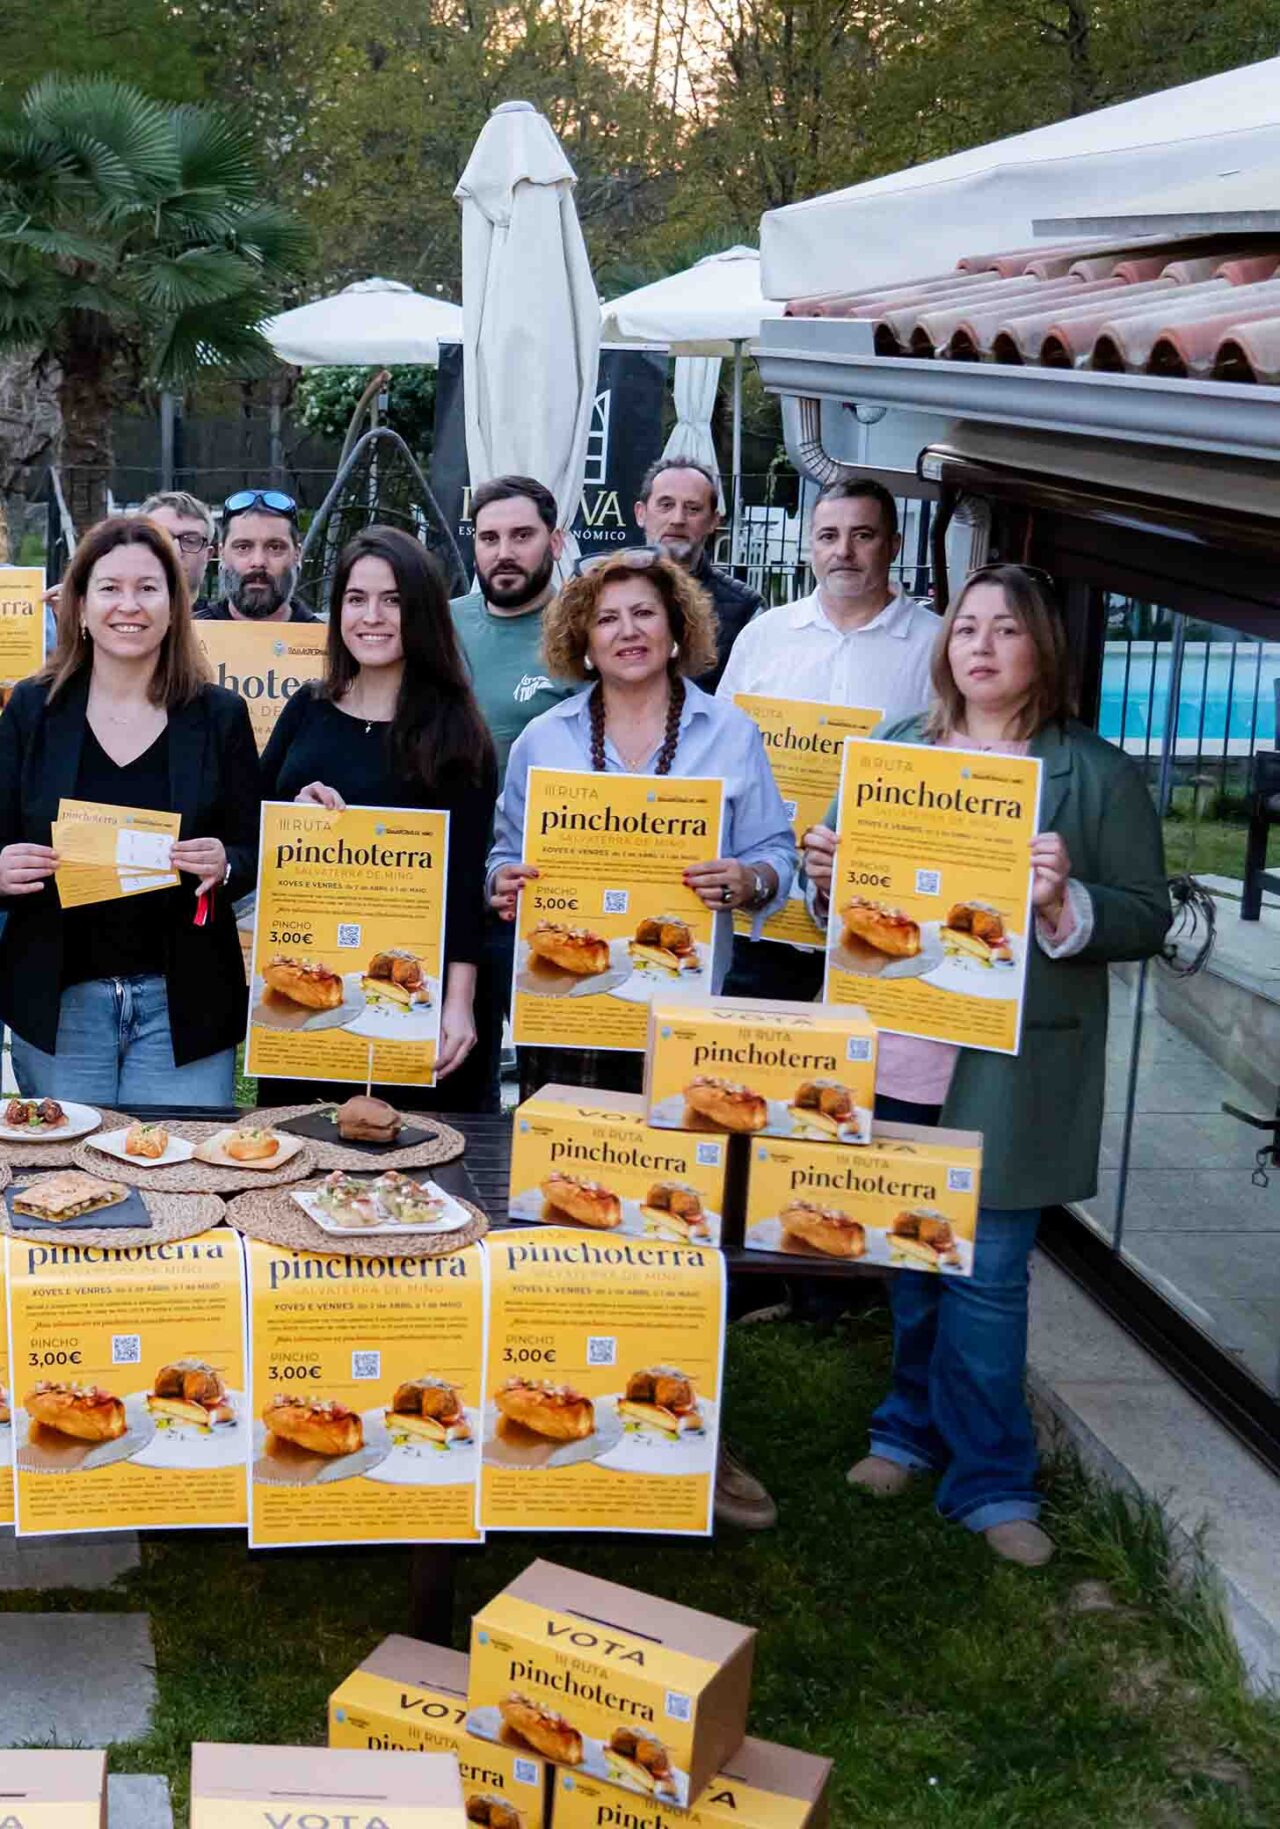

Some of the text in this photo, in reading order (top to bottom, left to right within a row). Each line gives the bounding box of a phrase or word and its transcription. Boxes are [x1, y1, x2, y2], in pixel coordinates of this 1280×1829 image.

[558, 786, 599, 800] RUTA
[856, 777, 1022, 819] pinchoterra
[292, 819, 332, 831] RUTA
[541, 805, 707, 836] pinchoterra
[276, 838, 432, 869] pinchoterra
[313, 881, 343, 890] VENRES
[847, 872, 891, 888] 3,00€
[534, 897, 578, 911] 3,00€
[272, 920, 311, 929] PINCHO
[269, 931, 313, 946] 3,00€
[694, 1041, 837, 1071] pinchoterra
[550, 1138, 687, 1173] pinchoterra
[791, 1166, 937, 1200] pinchoterra
[507, 1242, 705, 1271] pinchoterra
[270, 1252, 466, 1289] pinchoterra
[75, 1286, 112, 1296] VENRES
[555, 1287, 591, 1295] VENRES
[274, 1303, 305, 1311] XOVES
[317, 1302, 354, 1311] VENRES
[30, 1338, 78, 1348] PINCHO
[506, 1335, 555, 1345] PINCHO
[29, 1351, 82, 1368] 3,00€
[271, 1352, 319, 1363] PINCHO
[502, 1348, 556, 1363] 3,00€
[268, 1366, 322, 1383] 3,00€
[545, 1620, 646, 1667] VOTA
[570, 1658, 610, 1680] RUTA
[508, 1658, 656, 1723] pinchoterra
[424, 1731, 461, 1750] RUTA
